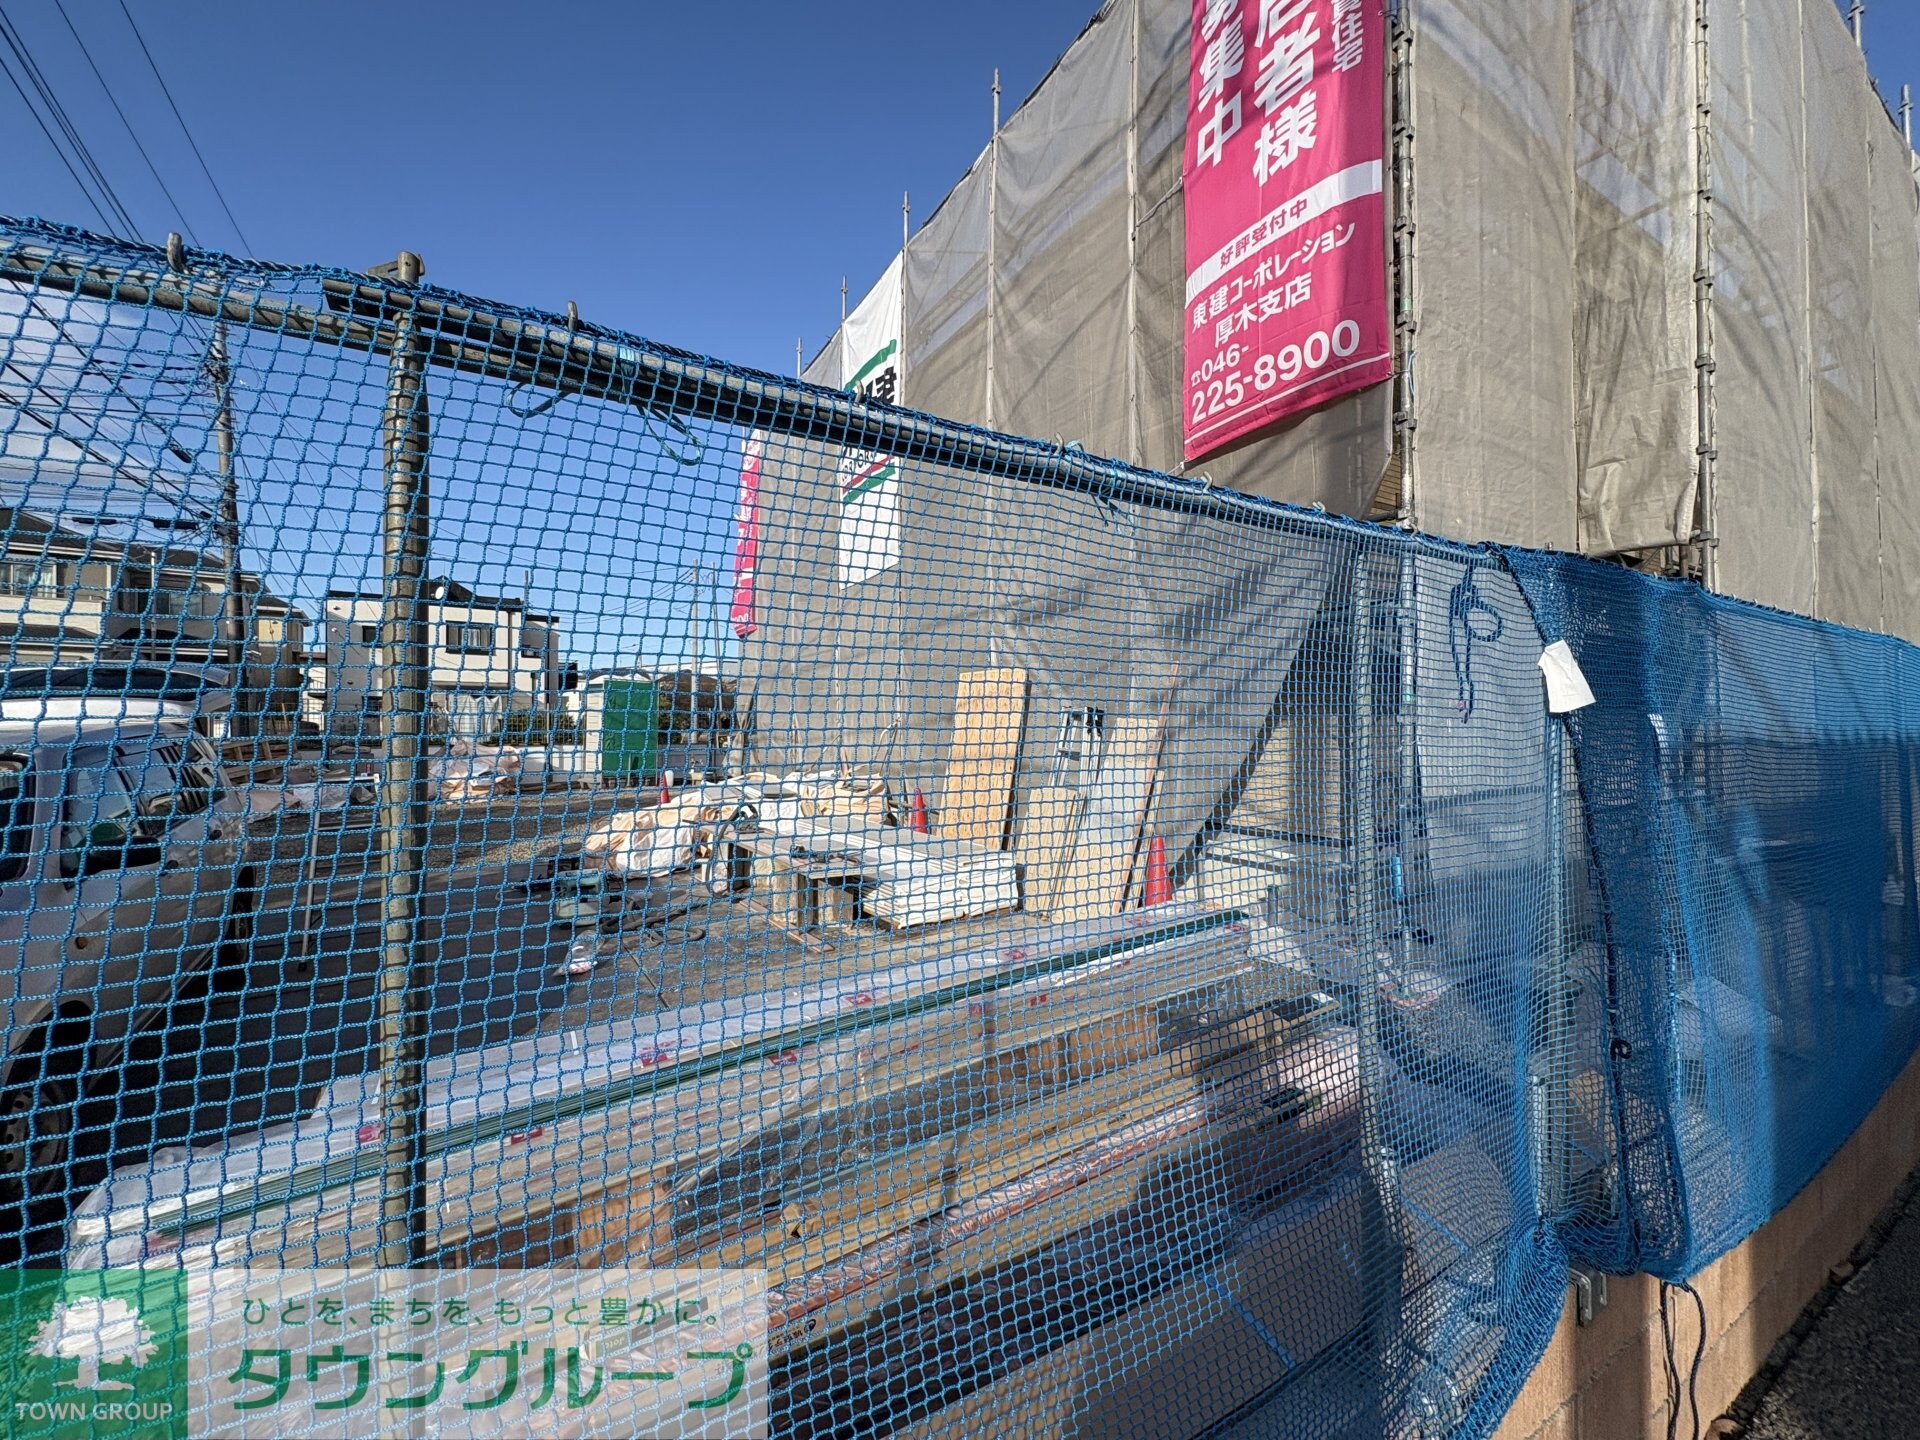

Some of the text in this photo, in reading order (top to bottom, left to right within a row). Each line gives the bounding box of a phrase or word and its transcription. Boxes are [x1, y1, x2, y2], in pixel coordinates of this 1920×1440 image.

[1192, 222, 1356, 334] 東建コーポレーション
[1219, 198, 1308, 270] 好評受付中
[1214, 271, 1312, 349] 厚木支店
[1191, 319, 1361, 425] 225-8900
